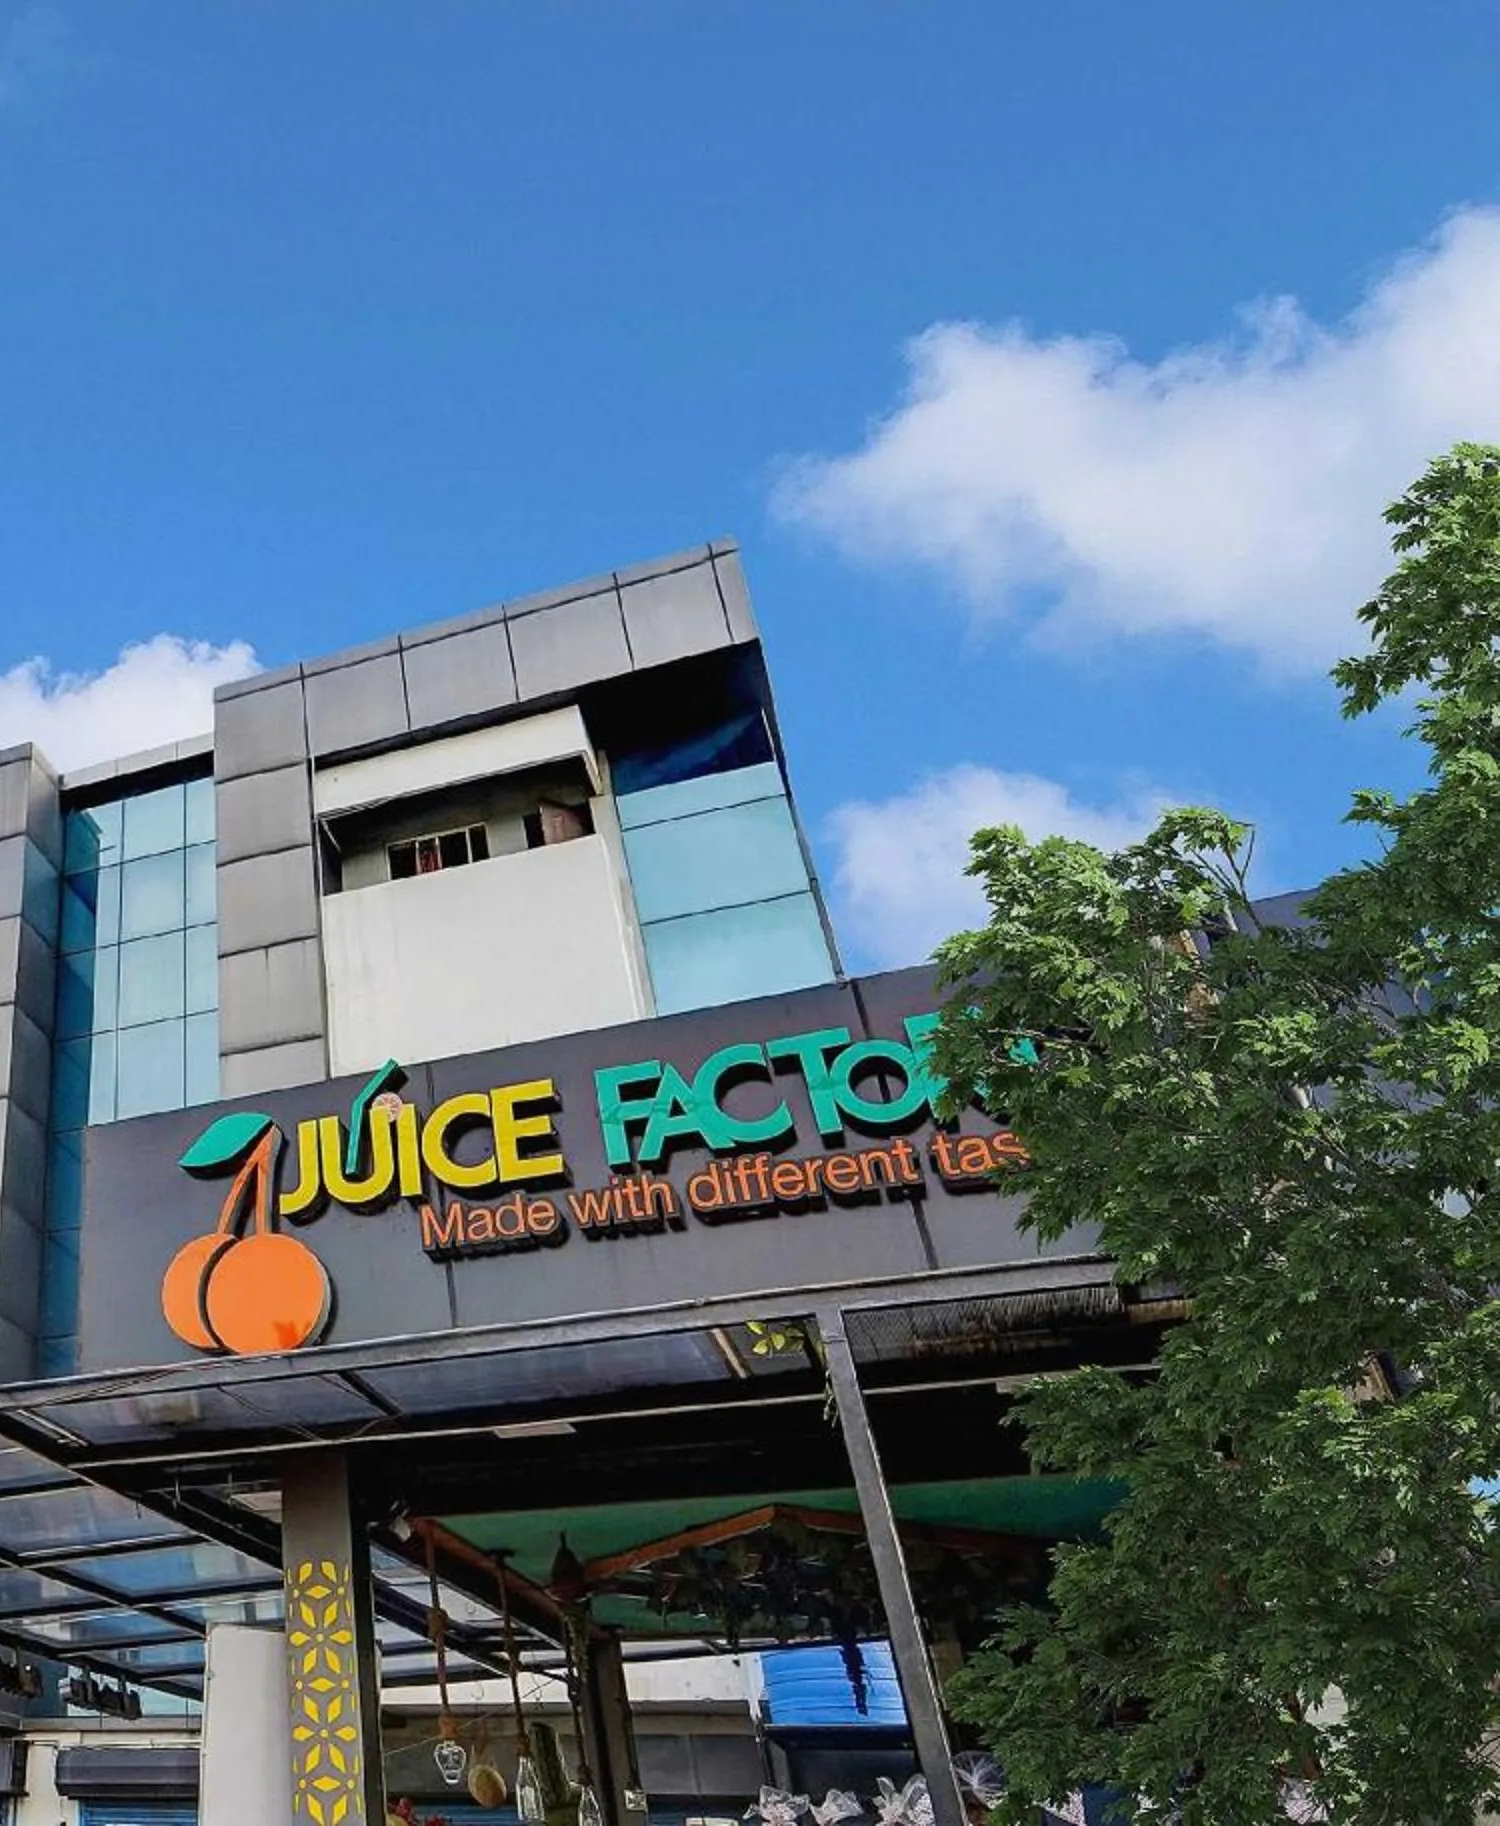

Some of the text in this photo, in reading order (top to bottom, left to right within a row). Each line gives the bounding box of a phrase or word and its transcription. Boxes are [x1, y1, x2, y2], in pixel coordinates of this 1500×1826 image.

[280, 1010, 1040, 1217] JUICE FACTO
[419, 1129, 1031, 1251] Made with different tas
